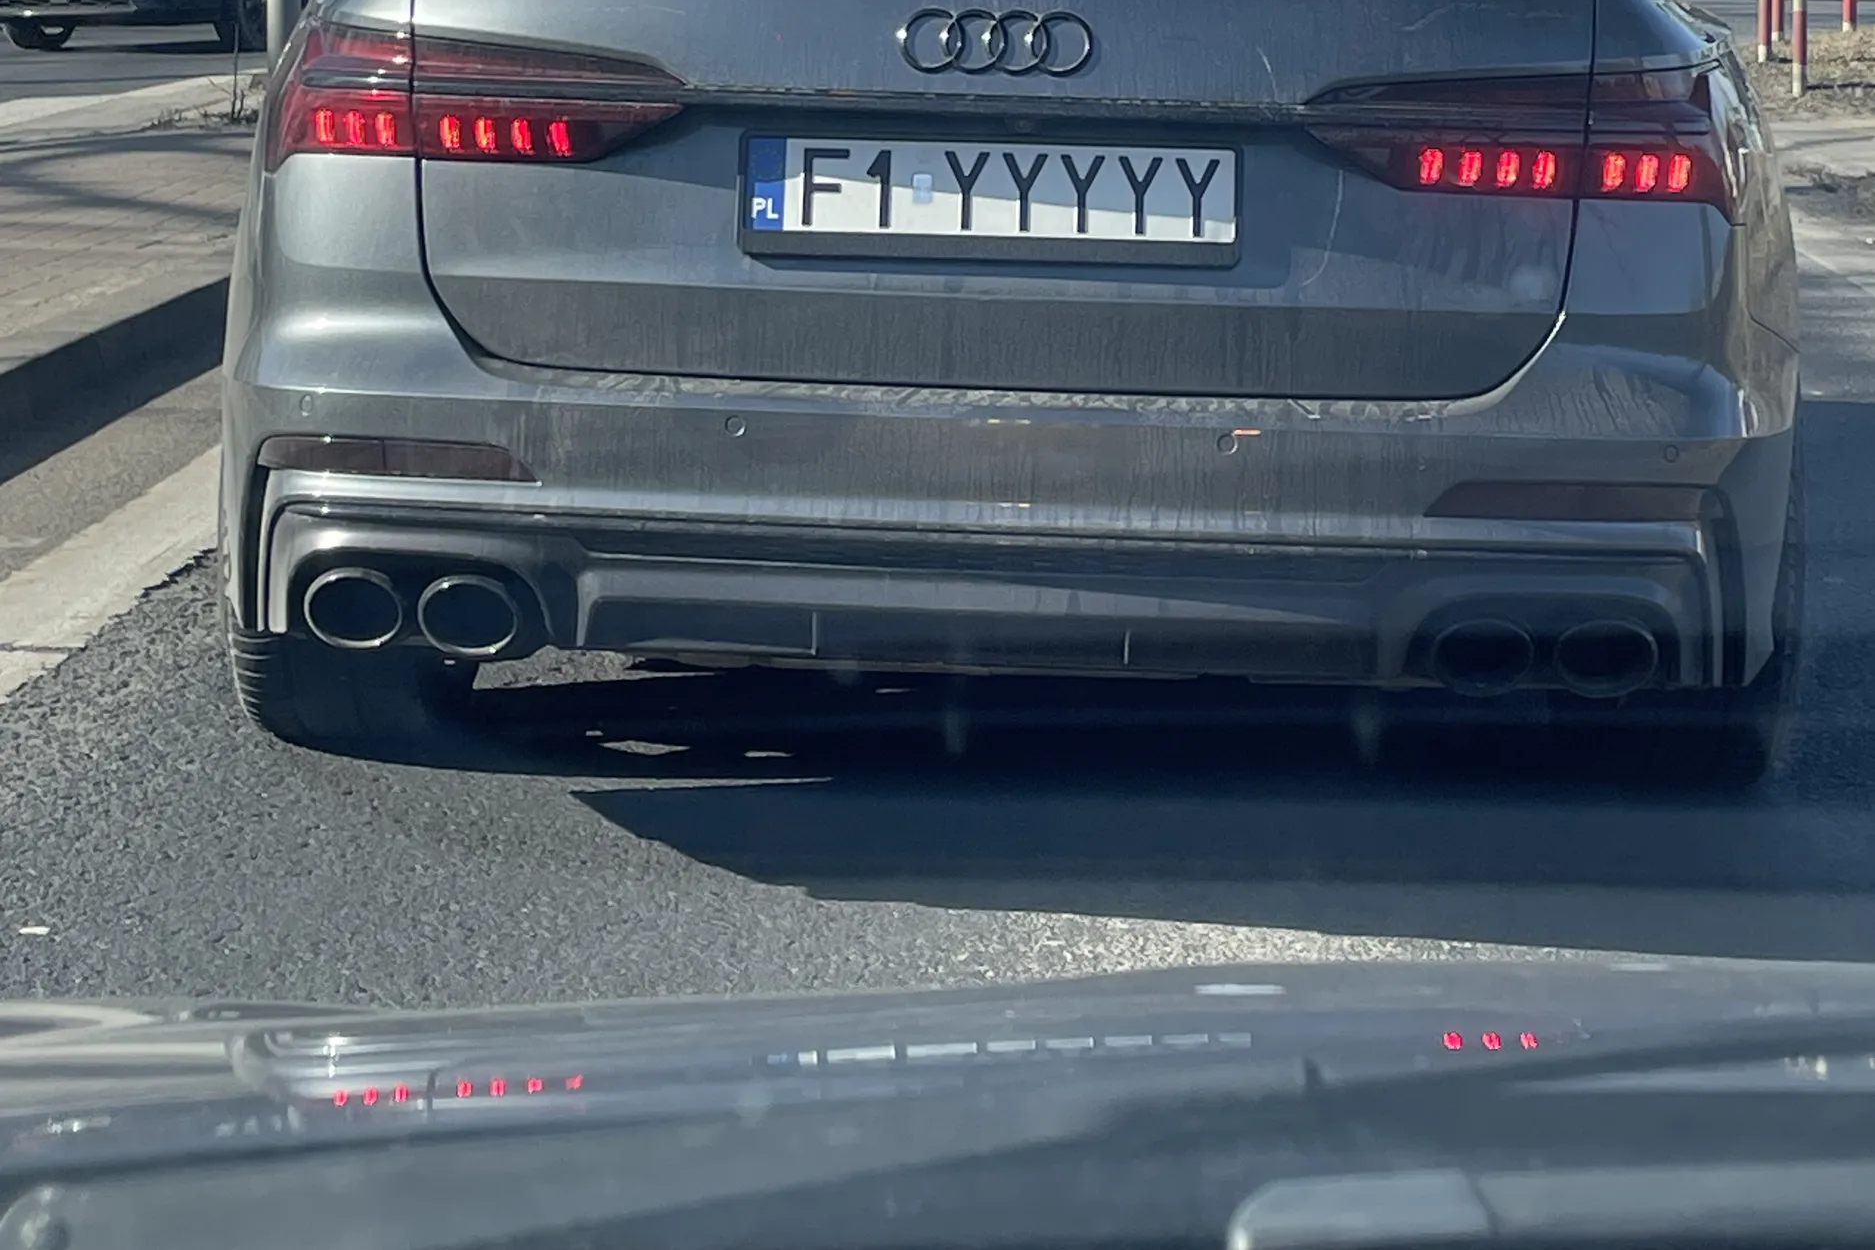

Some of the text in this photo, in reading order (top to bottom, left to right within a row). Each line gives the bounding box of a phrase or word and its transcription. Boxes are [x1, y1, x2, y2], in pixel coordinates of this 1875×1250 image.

[751, 197, 779, 220] PL
[801, 148, 1221, 238] F1 YYYYY
